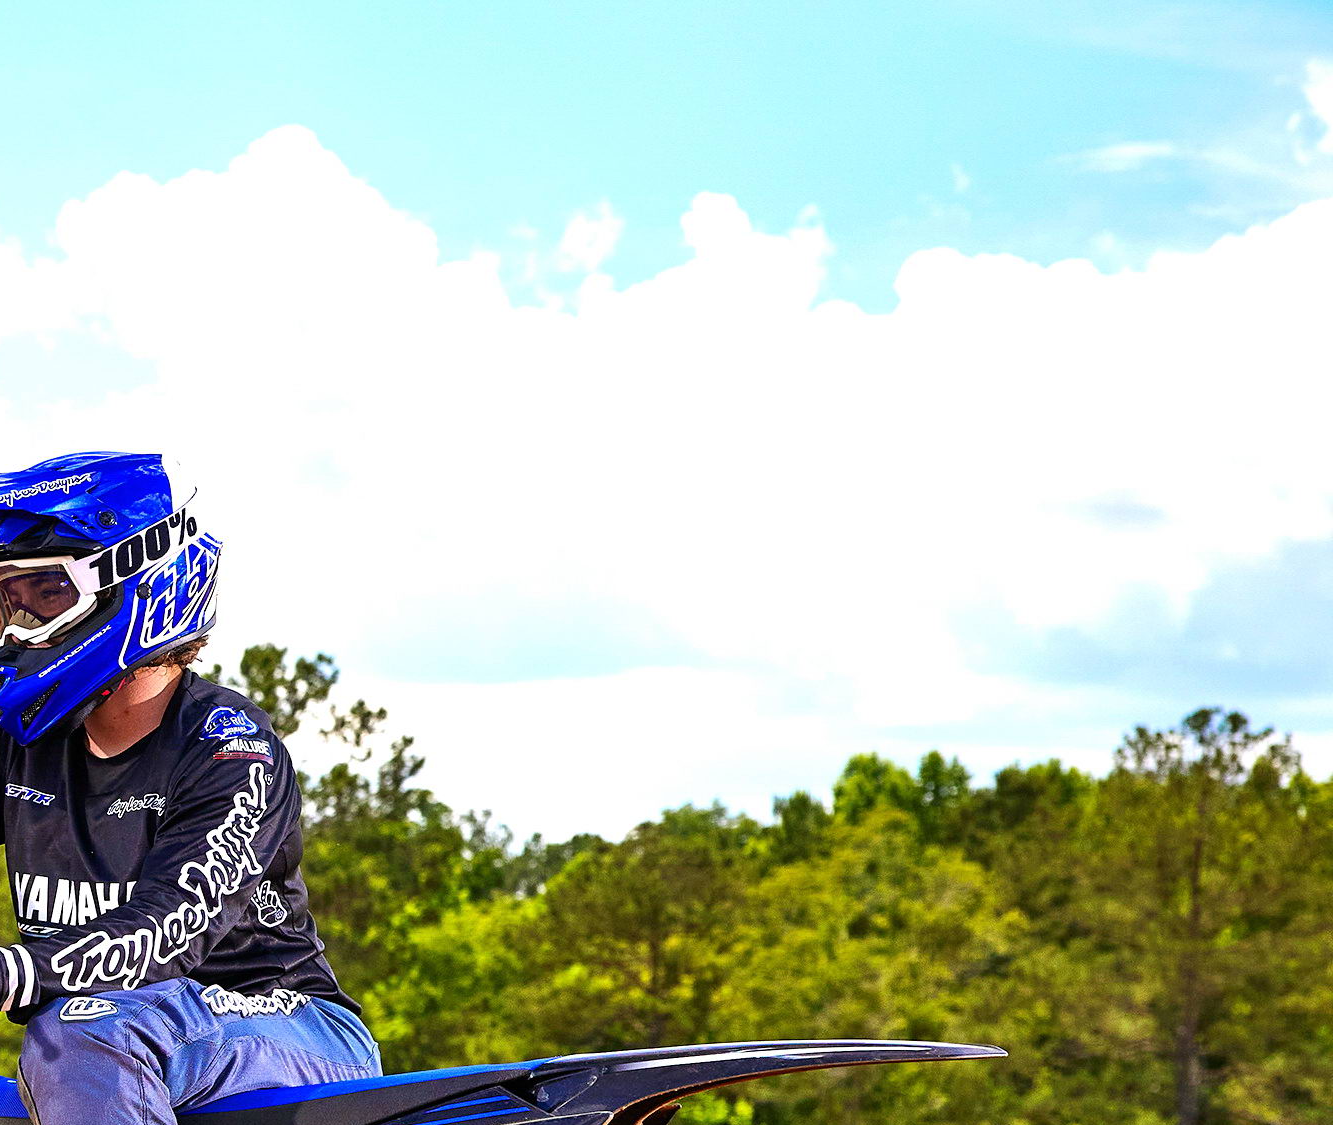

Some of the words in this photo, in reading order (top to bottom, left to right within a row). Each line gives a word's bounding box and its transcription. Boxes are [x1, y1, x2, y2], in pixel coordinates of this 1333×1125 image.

[36, 472, 93, 494] Designs
[89, 507, 198, 589] 100%
[38, 645, 85, 679] GRAND
[219, 738, 272, 757] AMALUBE
[51, 930, 154, 992] Troy
[146, 914, 209, 965] Lee
[178, 762, 266, 919] Designs
